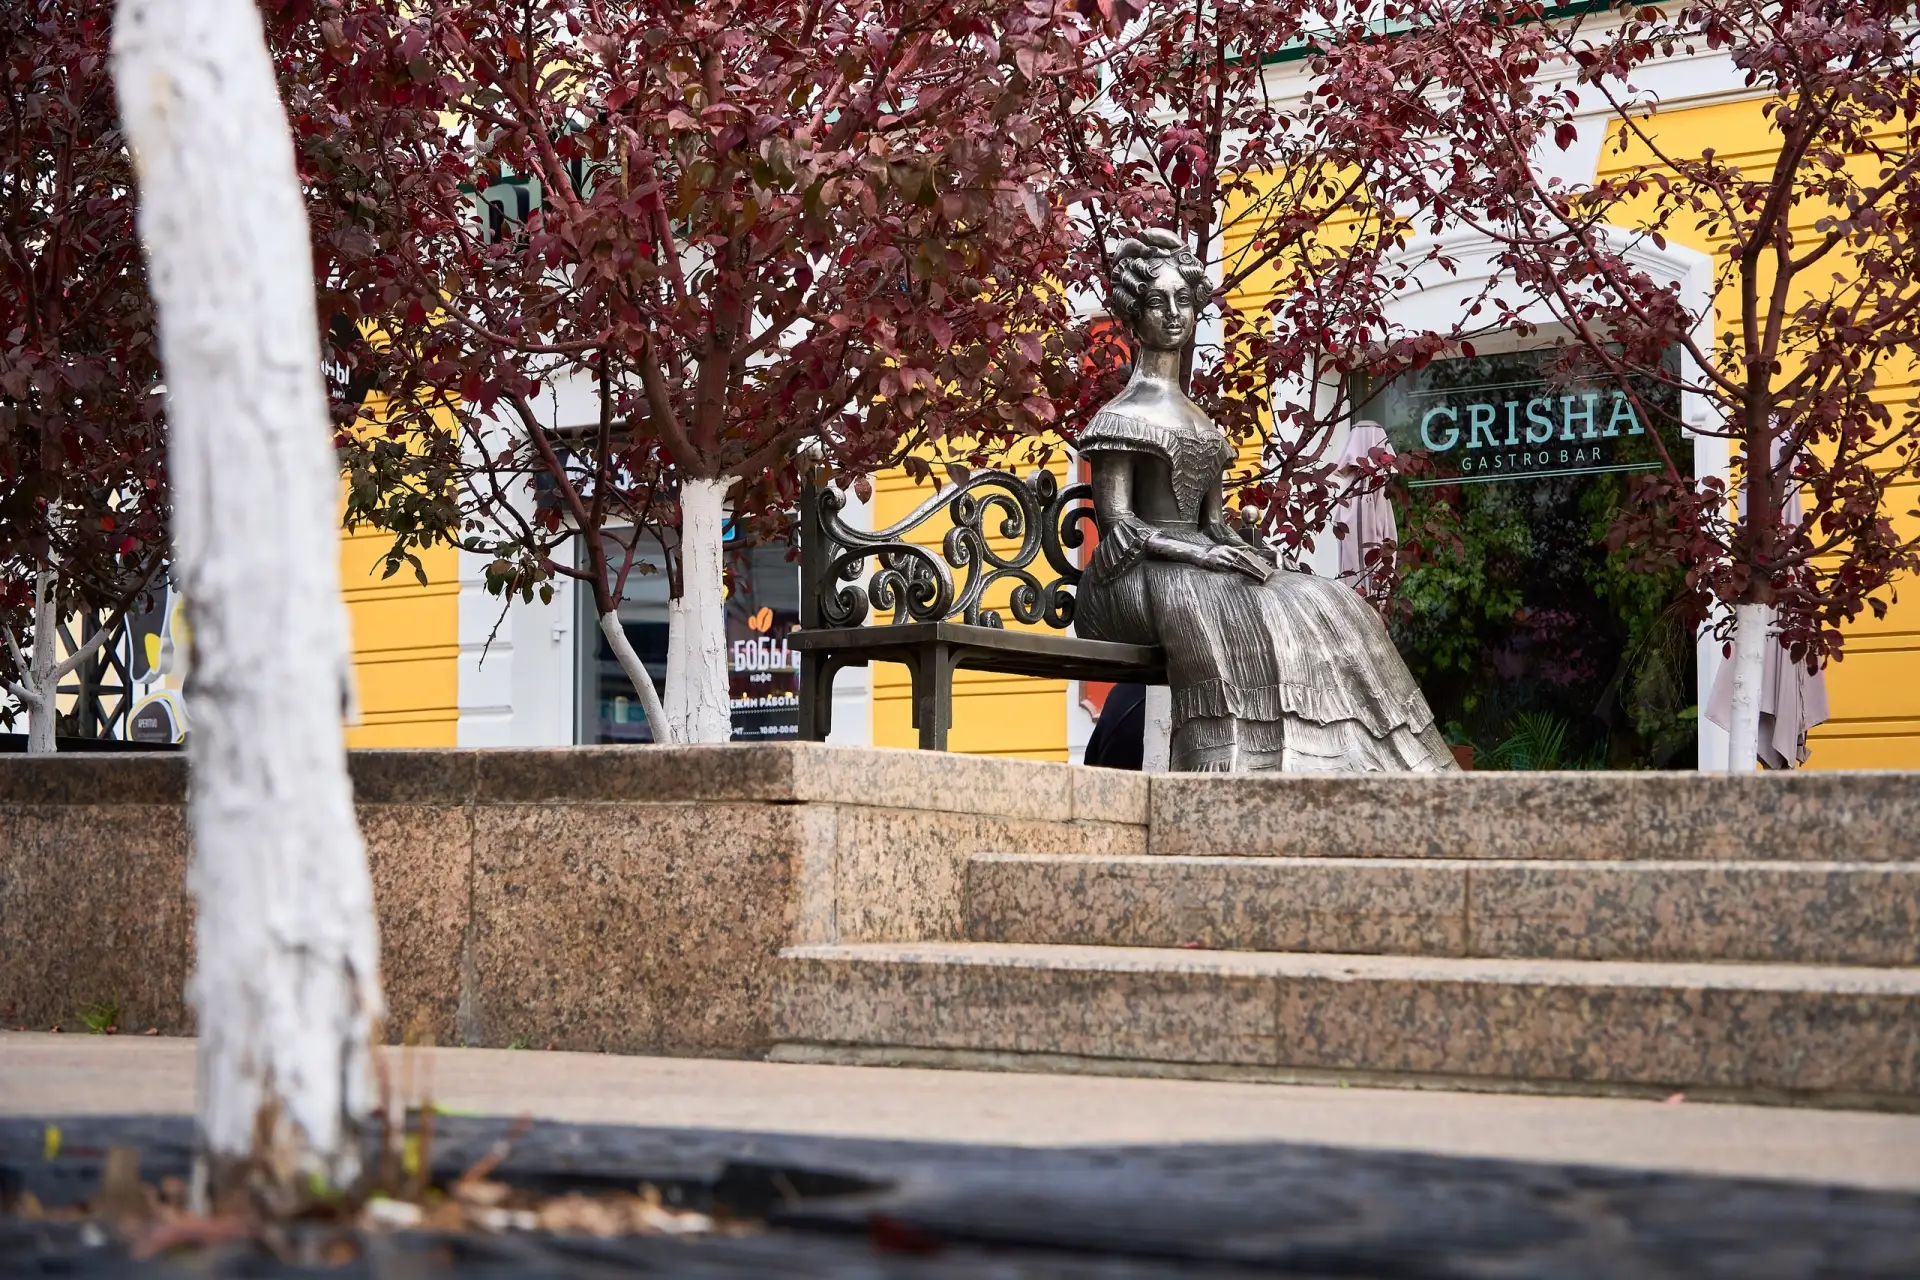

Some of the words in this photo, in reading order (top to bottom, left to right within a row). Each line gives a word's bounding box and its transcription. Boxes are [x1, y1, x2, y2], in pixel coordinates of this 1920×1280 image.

[1420, 391, 1645, 451] GRISHA
[1462, 451, 1549, 471] GASTRO
[1560, 446, 1601, 463] BAR
[734, 636, 788, 672] БОБЫ
[730, 697, 758, 709] ЕЖИМ
[759, 695, 799, 707] РАБОТЫ
